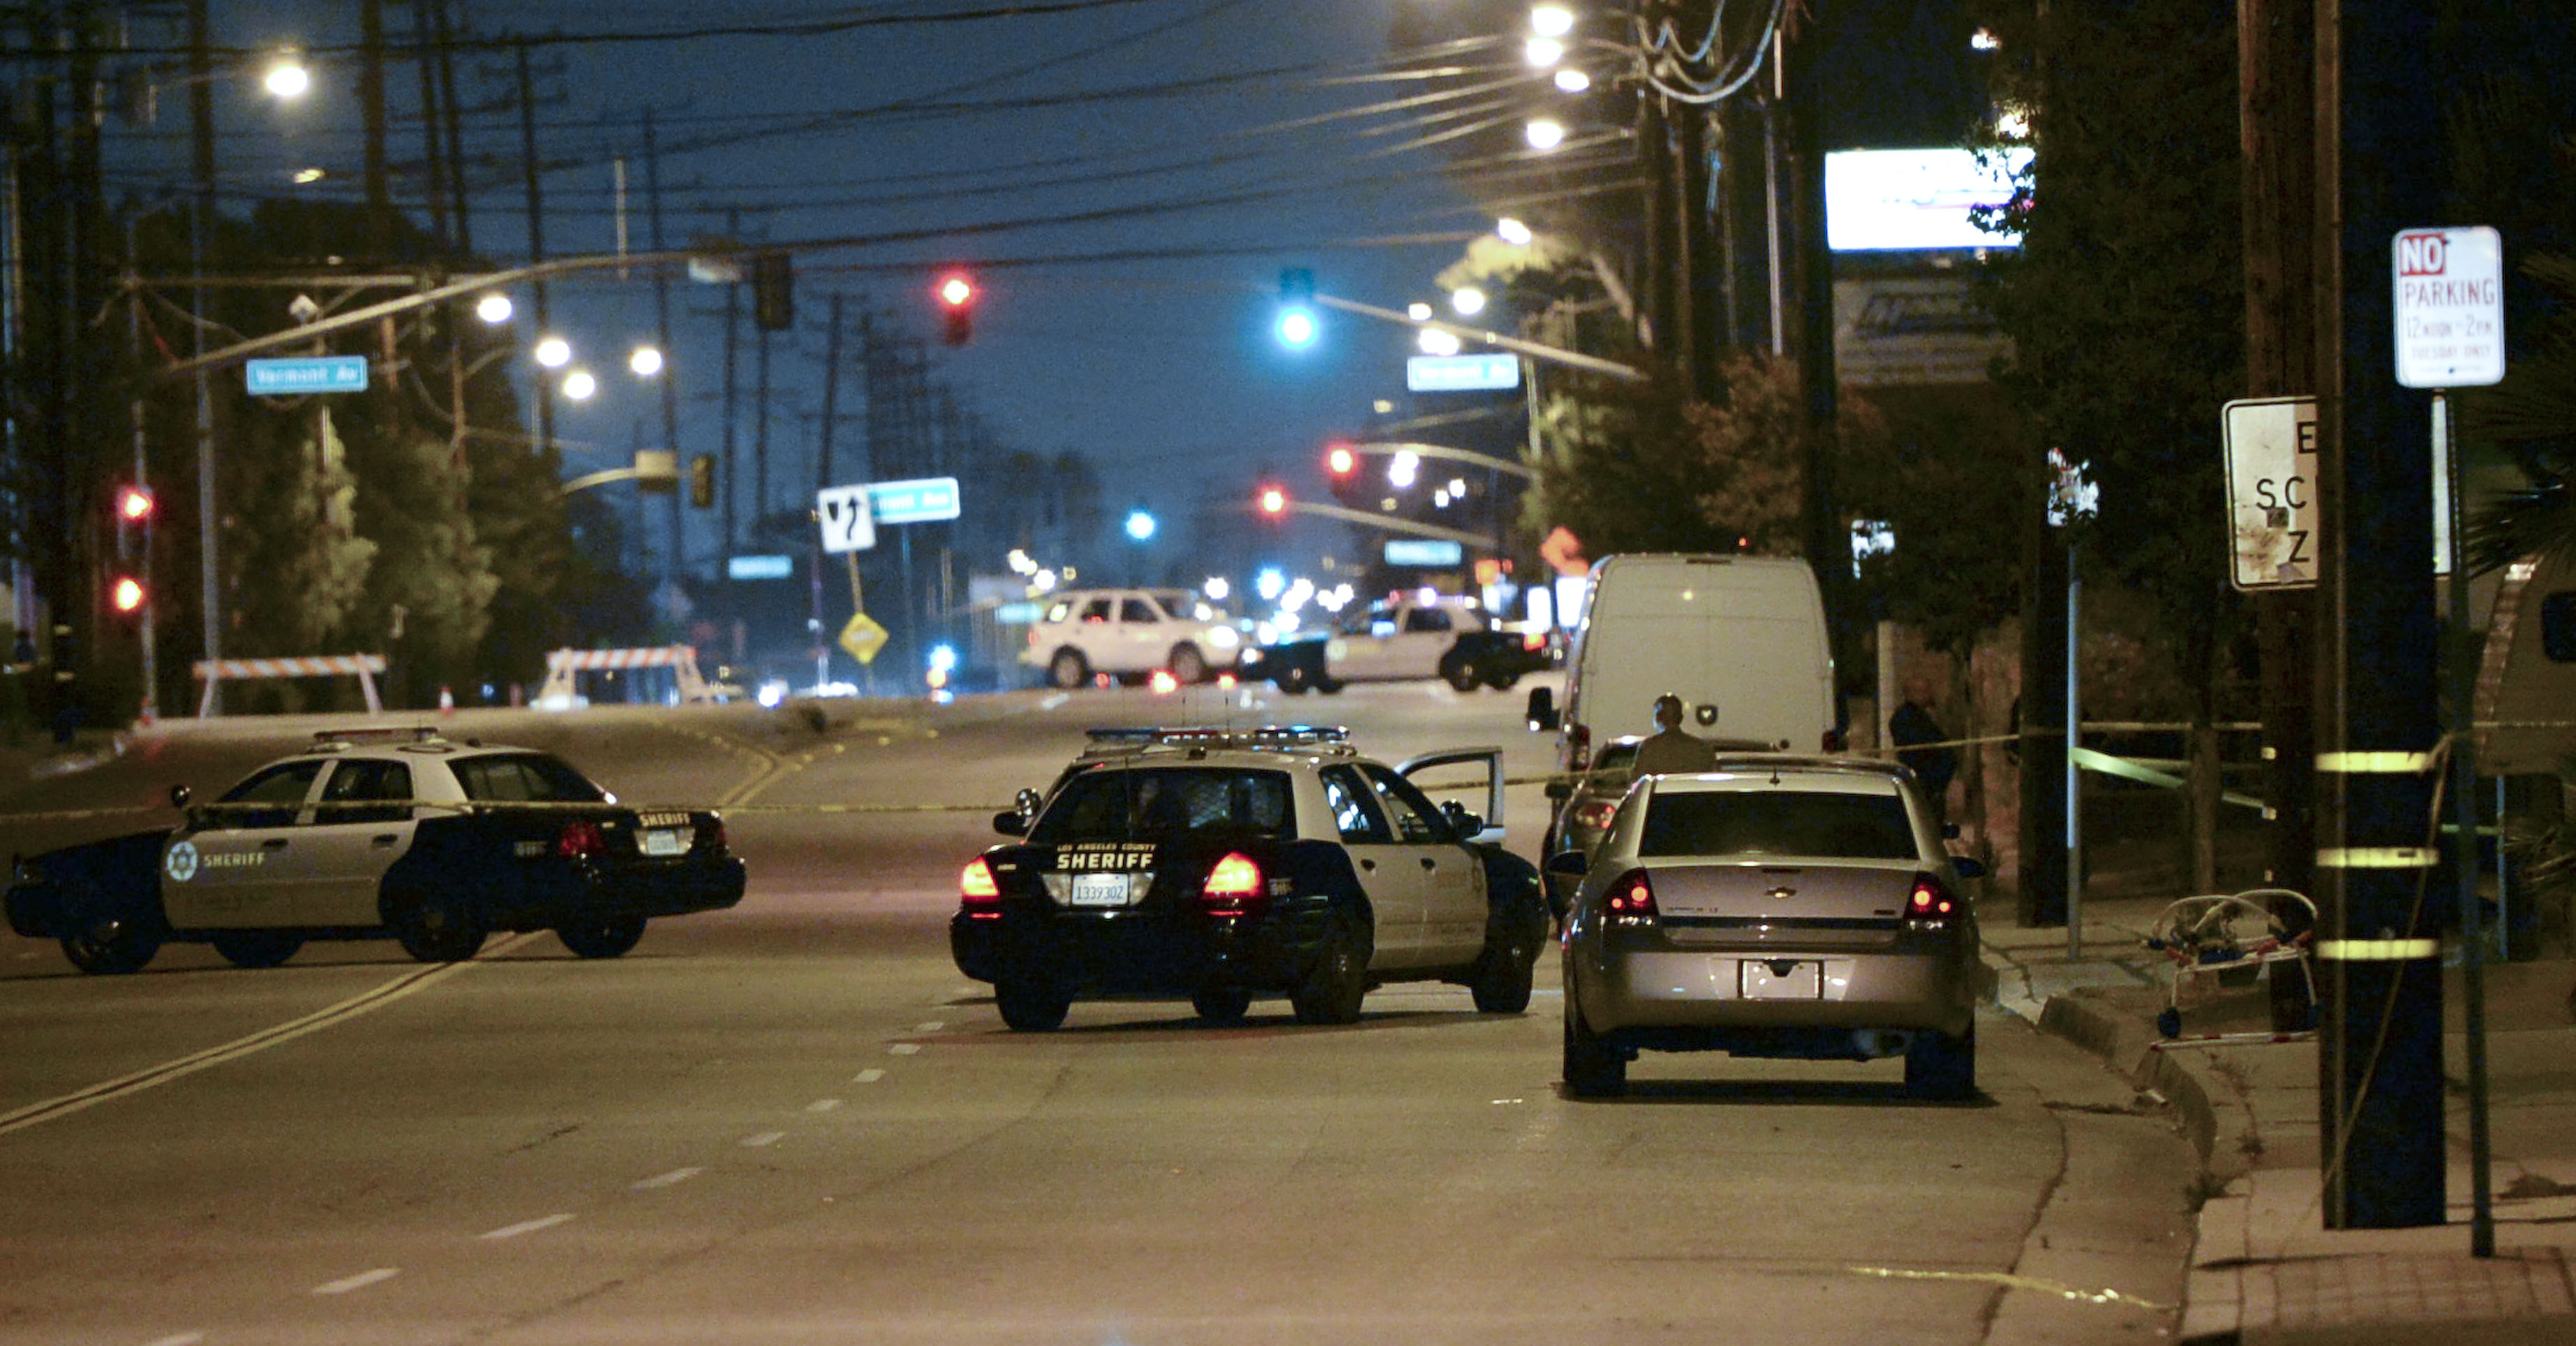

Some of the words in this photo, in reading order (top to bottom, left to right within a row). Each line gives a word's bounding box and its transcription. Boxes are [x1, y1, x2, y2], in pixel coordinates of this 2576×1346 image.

[2401, 236, 2443, 273] NO
[2404, 278, 2494, 307] PARKING
[256, 366, 328, 384] Vermont
[639, 812, 691, 827] SHERIFF
[1057, 843, 1073, 852] LOS
[1076, 842, 1117, 851] ANGELES
[1121, 842, 1156, 851] COUNTY
[204, 851, 265, 867] SHERIFF
[1057, 853, 1154, 869] SHERIFF
